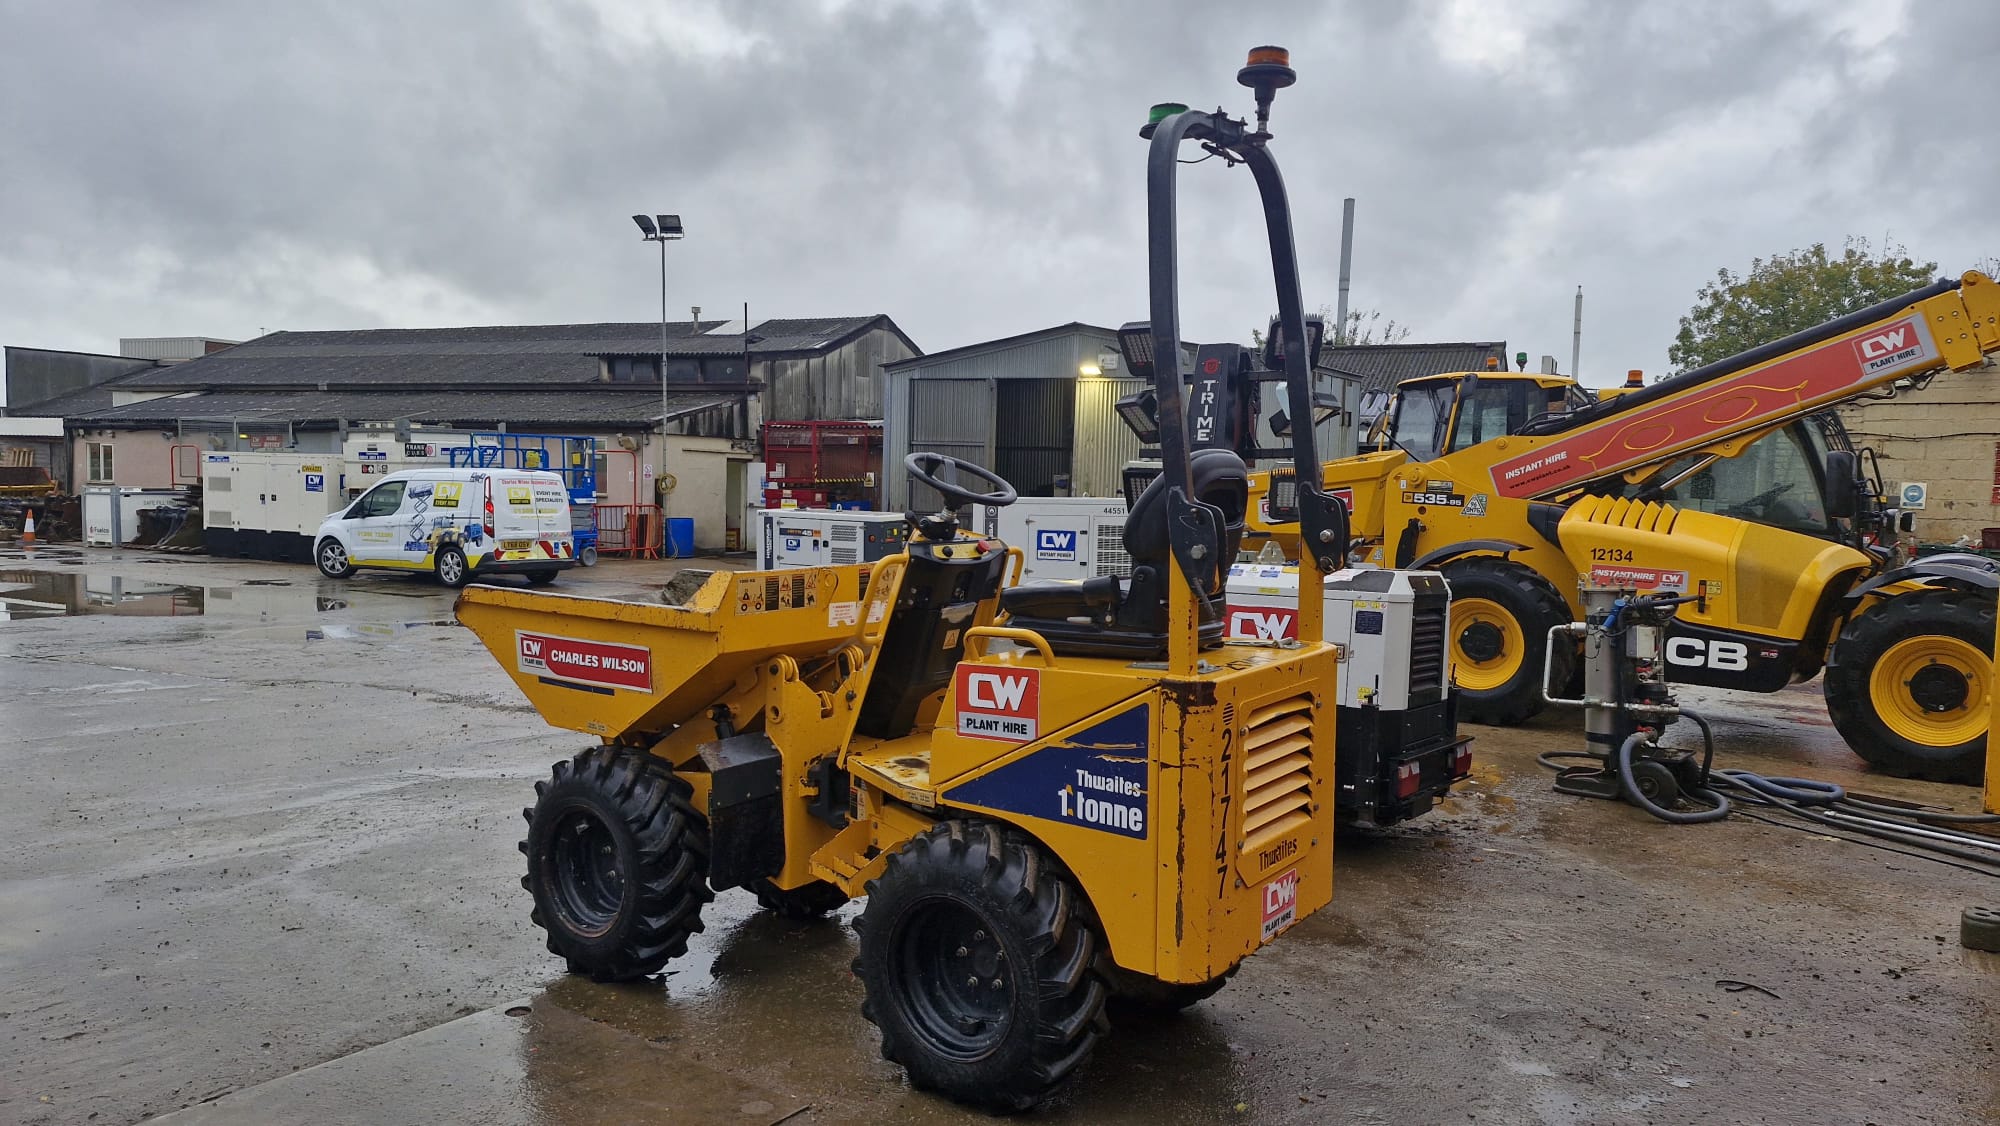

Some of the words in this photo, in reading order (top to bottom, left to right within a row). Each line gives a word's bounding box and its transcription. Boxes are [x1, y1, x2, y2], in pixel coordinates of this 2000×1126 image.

[1862, 328, 1905, 358] CW
[1870, 357, 1895, 369] PLANT
[1897, 349, 1916, 360] HIRE
[1196, 380, 1217, 441] TRIME
[1505, 459, 1545, 479] INSTANT
[1545, 451, 1567, 465] HIRE
[1103, 507, 1125, 515] 44551
[1041, 533, 1071, 549] CW
[1590, 548, 1633, 562] 12134
[1633, 572, 1656, 580] HIRE
[1662, 574, 1681, 583] CW
[1230, 612, 1292, 640] CW
[523, 640, 541, 656] CW
[551, 650, 599, 668] CHARLES
[602, 656, 645, 673] WILSON
[1665, 636, 1748, 671] CB
[968, 672, 1029, 711] CW
[966, 718, 999, 732] PLANT
[1002, 722, 1028, 735] HIRE
[1076, 769, 1141, 797] Thwaites
[1077, 791, 1143, 832] tonne
[1215, 728, 1233, 900] 21747
[1259, 838, 1297, 872] Thwaites
[1266, 876, 1295, 915] CW
[1265, 918, 1281, 934] PLANT
[1280, 910, 1292, 923] HIRE
